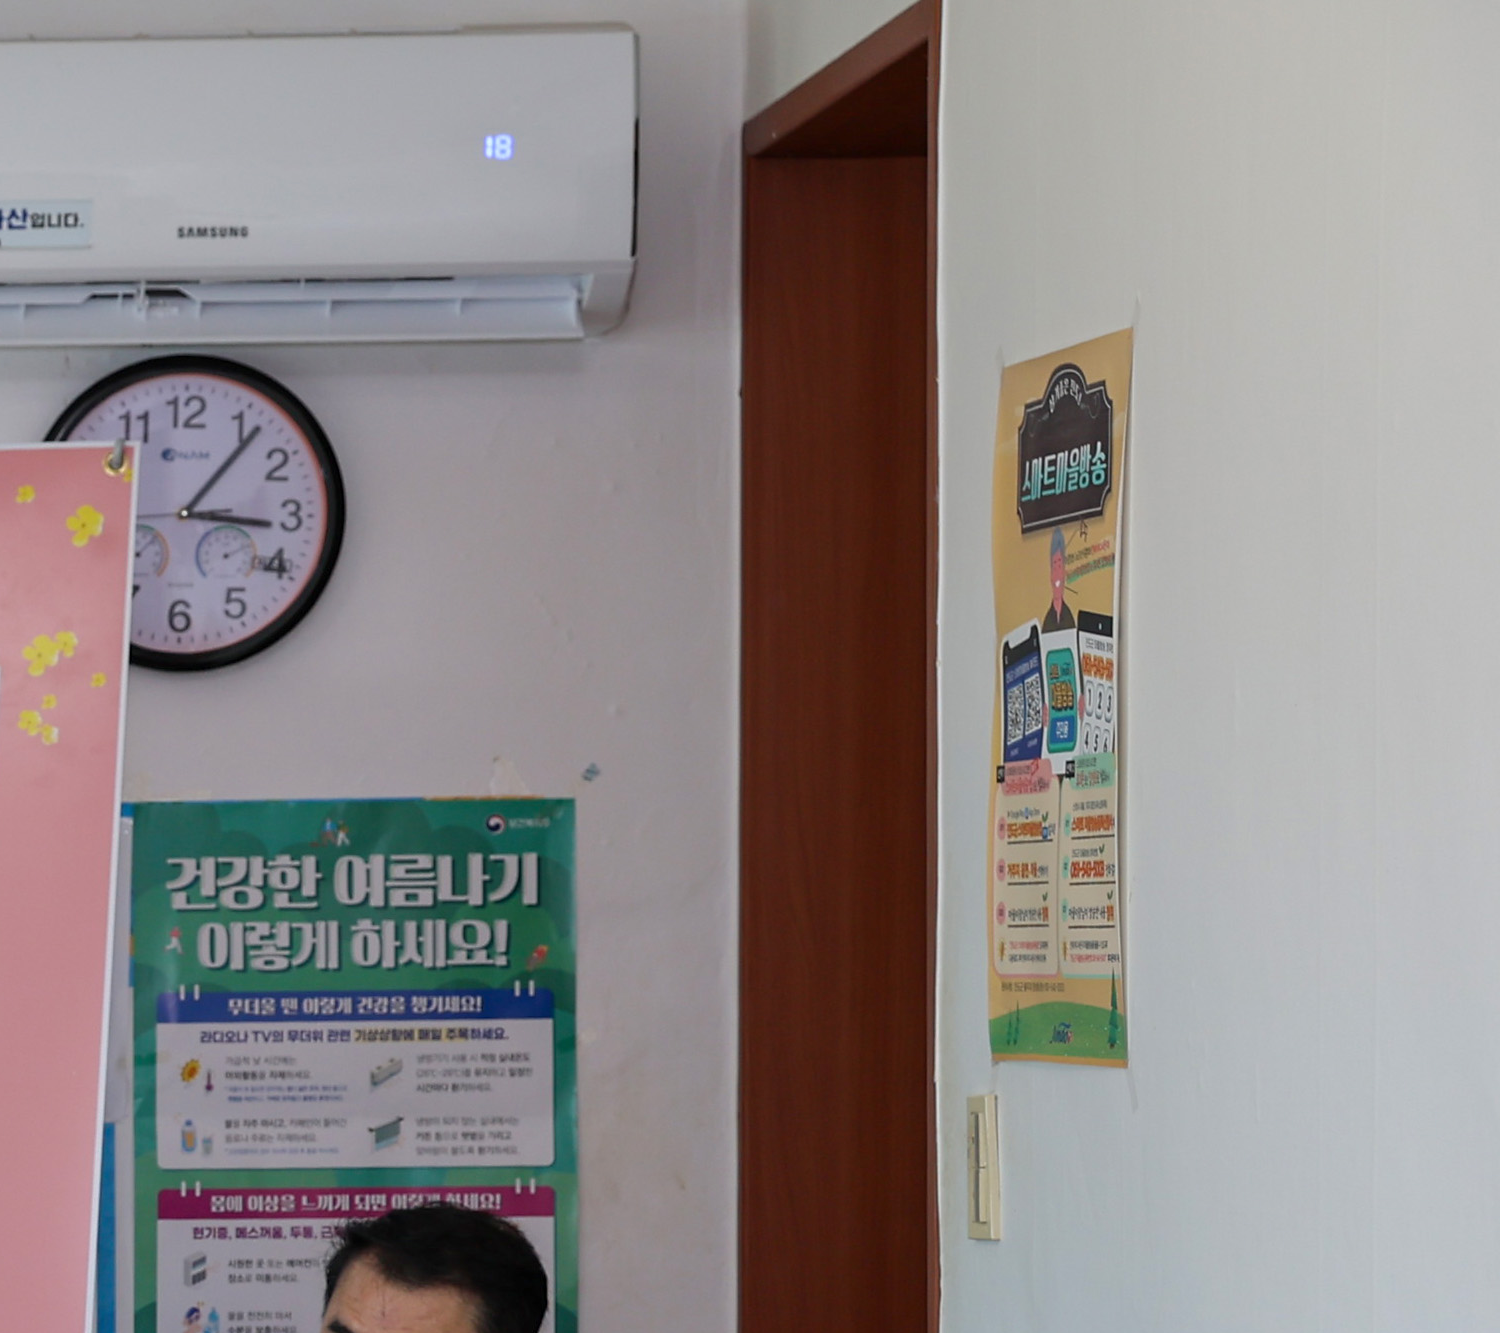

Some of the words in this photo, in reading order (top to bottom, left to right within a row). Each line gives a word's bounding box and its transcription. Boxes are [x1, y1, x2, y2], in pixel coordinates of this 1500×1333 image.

[484, 134, 513, 159] 18
[176, 226, 249, 239] SAMSUNG
[118, 410, 149, 443] 11
[166, 395, 207, 429] 12
[232, 411, 245, 444] 1
[265, 447, 290, 481] 2
[1021, 440, 1107, 502] 스마트마을방송
[280, 499, 303, 532] 3
[263, 547, 287, 579] 4
[167, 600, 192, 633] 6
[224, 587, 247, 619] 5
[165, 853, 324, 911] 건강한
[334, 851, 539, 909] 여름나기
[196, 919, 341, 972] 이렇게
[350, 917, 509, 969] 하세요!
[228, 997, 276, 1016] 무더울
[303, 997, 352, 1015] 이렇게
[357, 997, 405, 1014] 건강을
[411, 995, 483, 1014] 챙기세요!
[200, 1029, 248, 1043] 라디오나
[253, 1029, 284, 1043] TV의
[287, 1029, 324, 1043] 무더위
[327, 1029, 351, 1043] 관련
[355, 1028, 415, 1042] 기상상황에
[445, 1027, 510, 1042] 주목하세요.
[210, 1194, 243, 1212] 몸에
[247, 1194, 295, 1212] 이상을
[301, 1193, 350, 1211] 느끼게
[354, 1192, 387, 1210] 되면
[192, 1226, 233, 1240] 현기증,
[235, 1225, 288, 1240] 메스꺼움,
